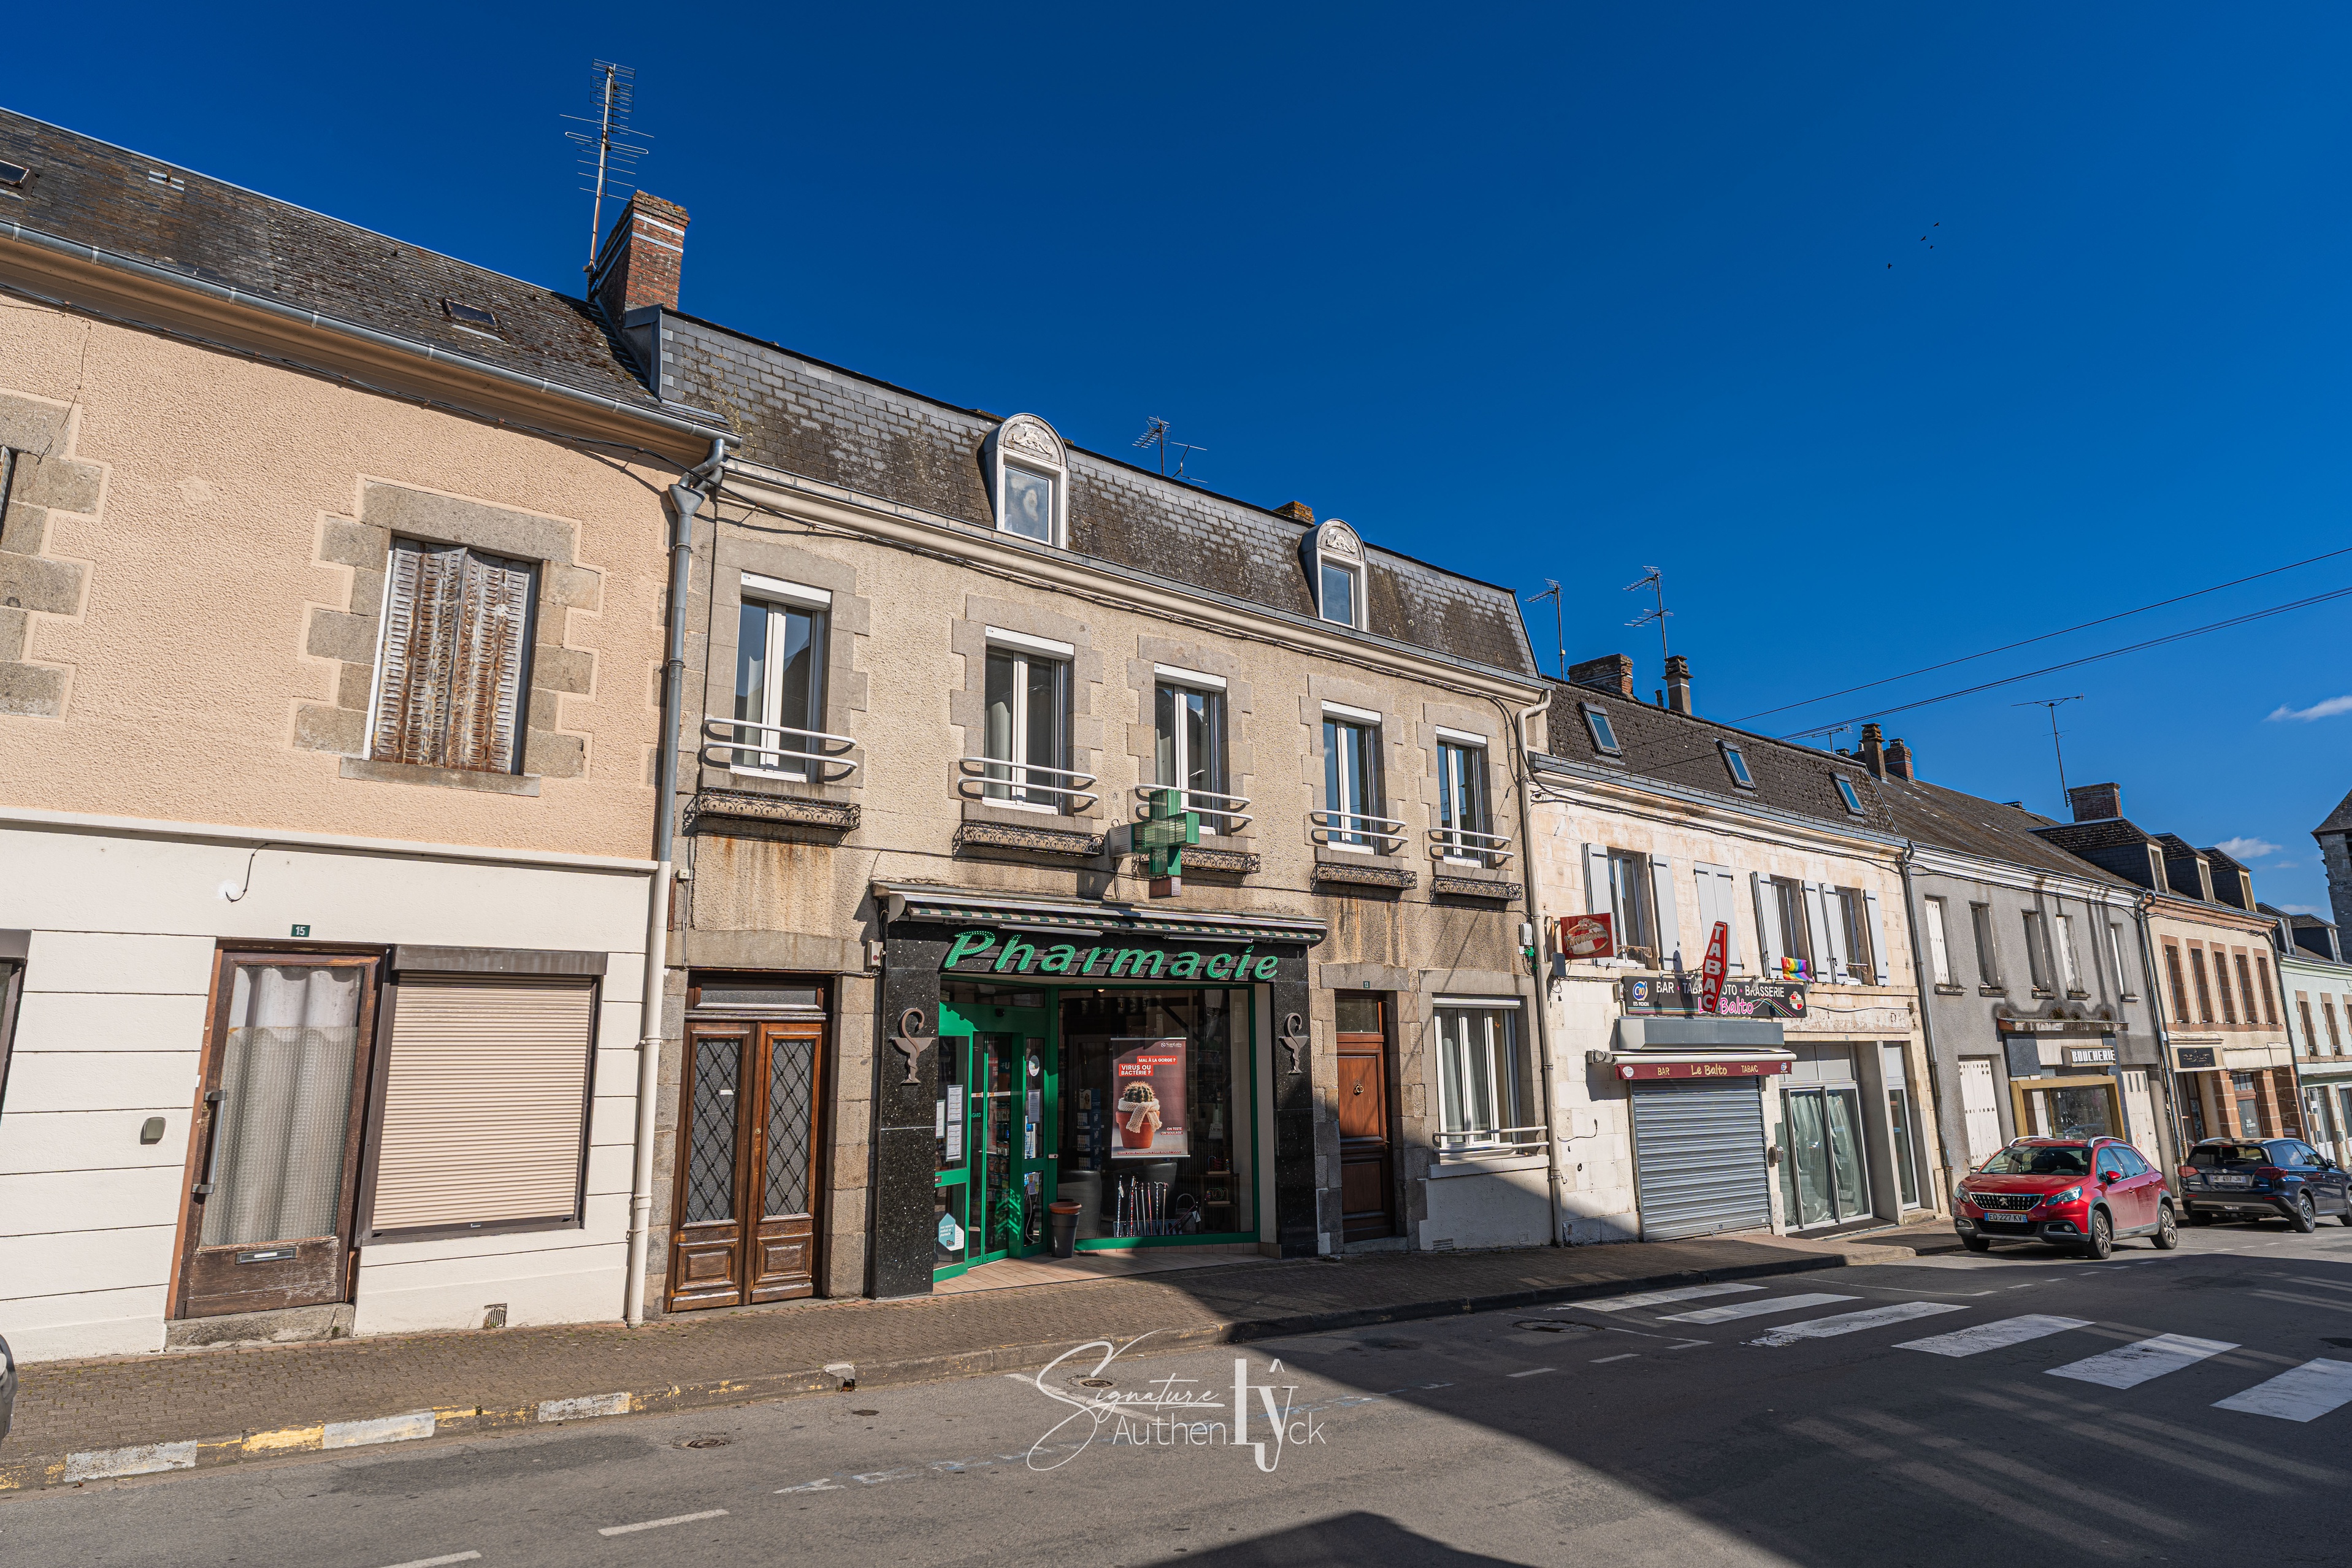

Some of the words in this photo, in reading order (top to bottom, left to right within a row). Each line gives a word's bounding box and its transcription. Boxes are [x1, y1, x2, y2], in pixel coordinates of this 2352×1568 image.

[296, 926, 306, 936] 15
[943, 931, 1278, 979] Pharmacie
[1703, 925, 1724, 1009] TABAC
[1634, 986, 1645, 996] C10
[1656, 981, 1675, 993] BAR
[1682, 982, 1703, 994] TABA
[1722, 984, 1737, 995] OTO
[1745, 985, 1785, 998] BRASSERIE
[1719, 996, 1754, 1015] Balto
[2072, 1050, 2116, 1062] BOUCHERIE
[1658, 1067, 1670, 1076] BAR
[1690, 1065, 1703, 1075] Le
[1704, 1063, 1728, 1075] Balto
